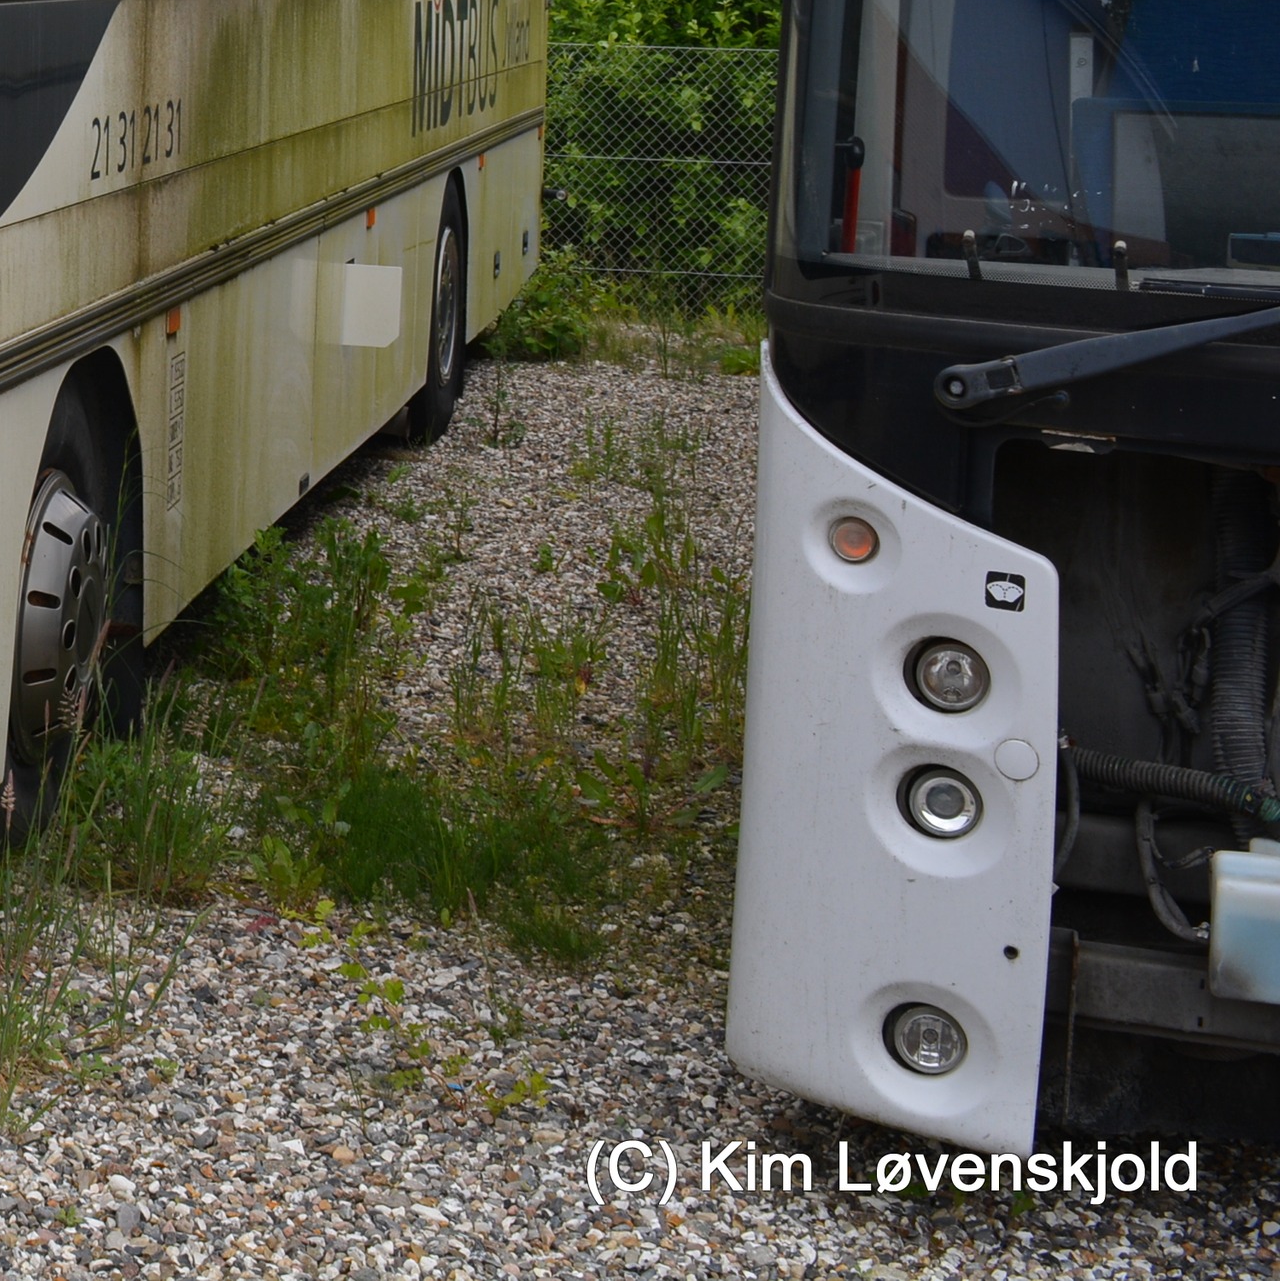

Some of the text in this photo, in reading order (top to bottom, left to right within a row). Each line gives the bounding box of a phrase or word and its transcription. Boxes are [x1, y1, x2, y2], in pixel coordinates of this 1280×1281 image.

[90, 98, 182, 180] 21 31 21 31
